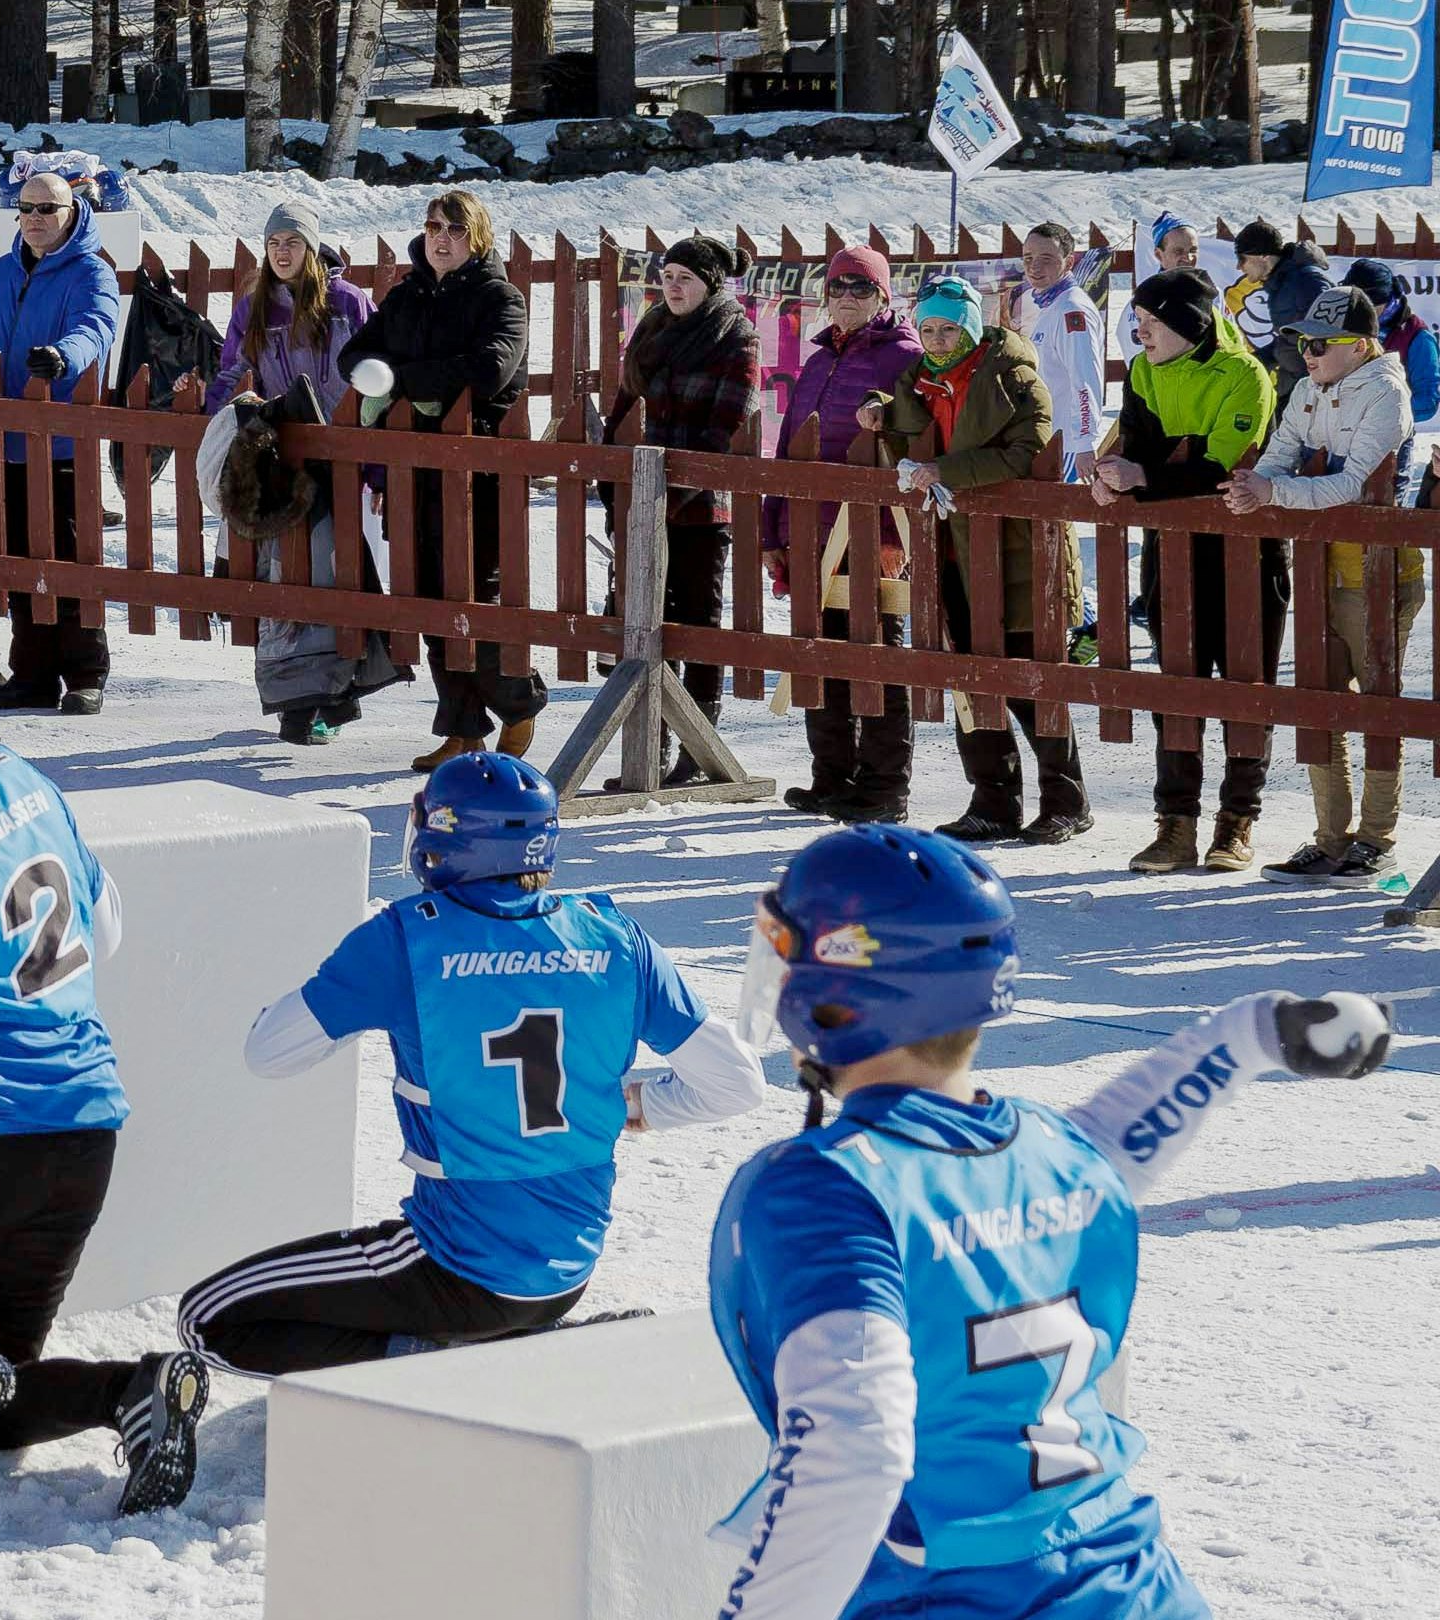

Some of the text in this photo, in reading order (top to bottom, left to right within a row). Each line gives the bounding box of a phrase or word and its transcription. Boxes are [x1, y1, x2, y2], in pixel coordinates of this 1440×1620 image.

[1349, 126, 1406, 154] TOUR
[0, 853, 92, 1000] 2
[415, 899, 440, 920] 1
[441, 950, 610, 979] YUKIGASSEN
[481, 1008, 570, 1138] 1
[965, 1286, 1104, 1491] 7
